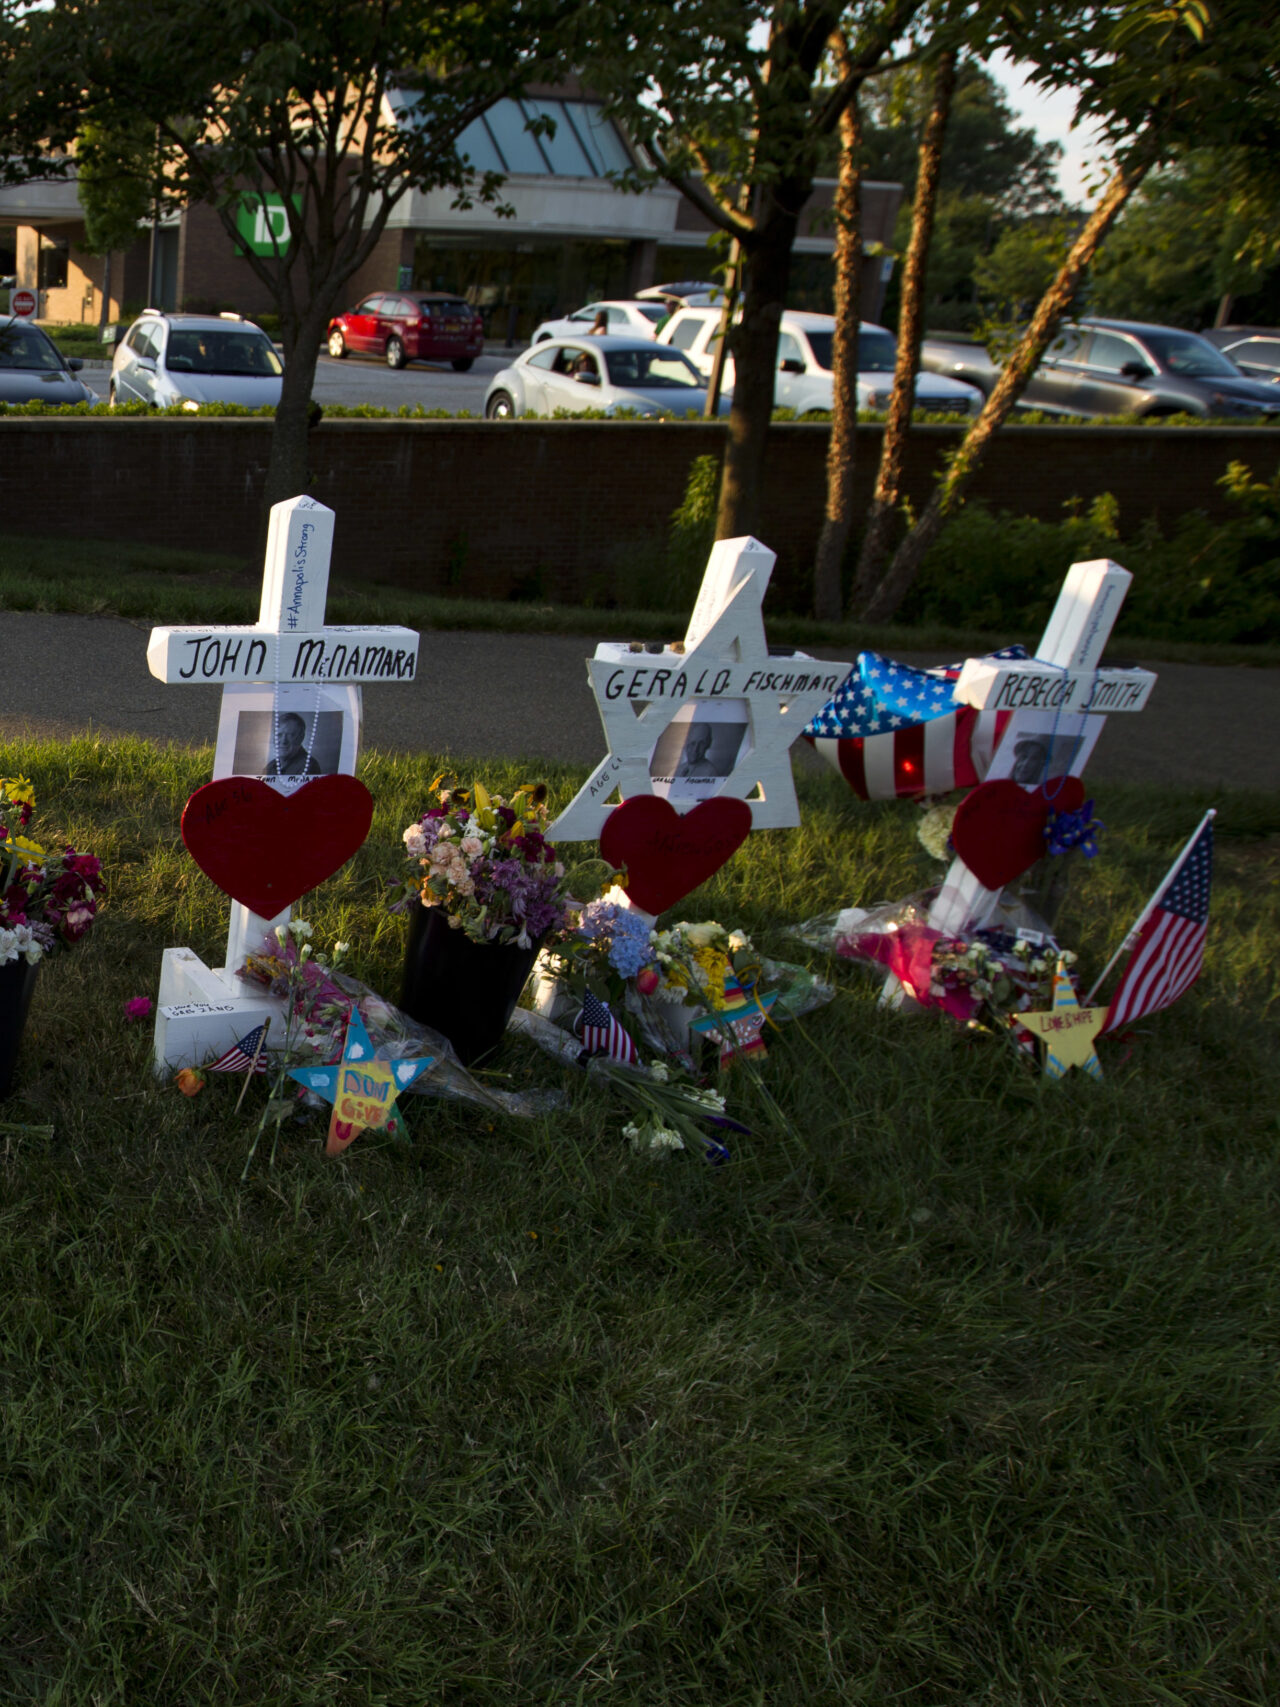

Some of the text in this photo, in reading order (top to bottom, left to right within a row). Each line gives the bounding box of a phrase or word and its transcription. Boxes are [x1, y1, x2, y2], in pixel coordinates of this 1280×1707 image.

[286, 523, 315, 630] #AnnapolisStrong
[179, 635, 267, 678] JOHN
[605, 669, 839, 699] GERALD FISCHMAN
[993, 673, 1147, 709] REBECCA SMITH
